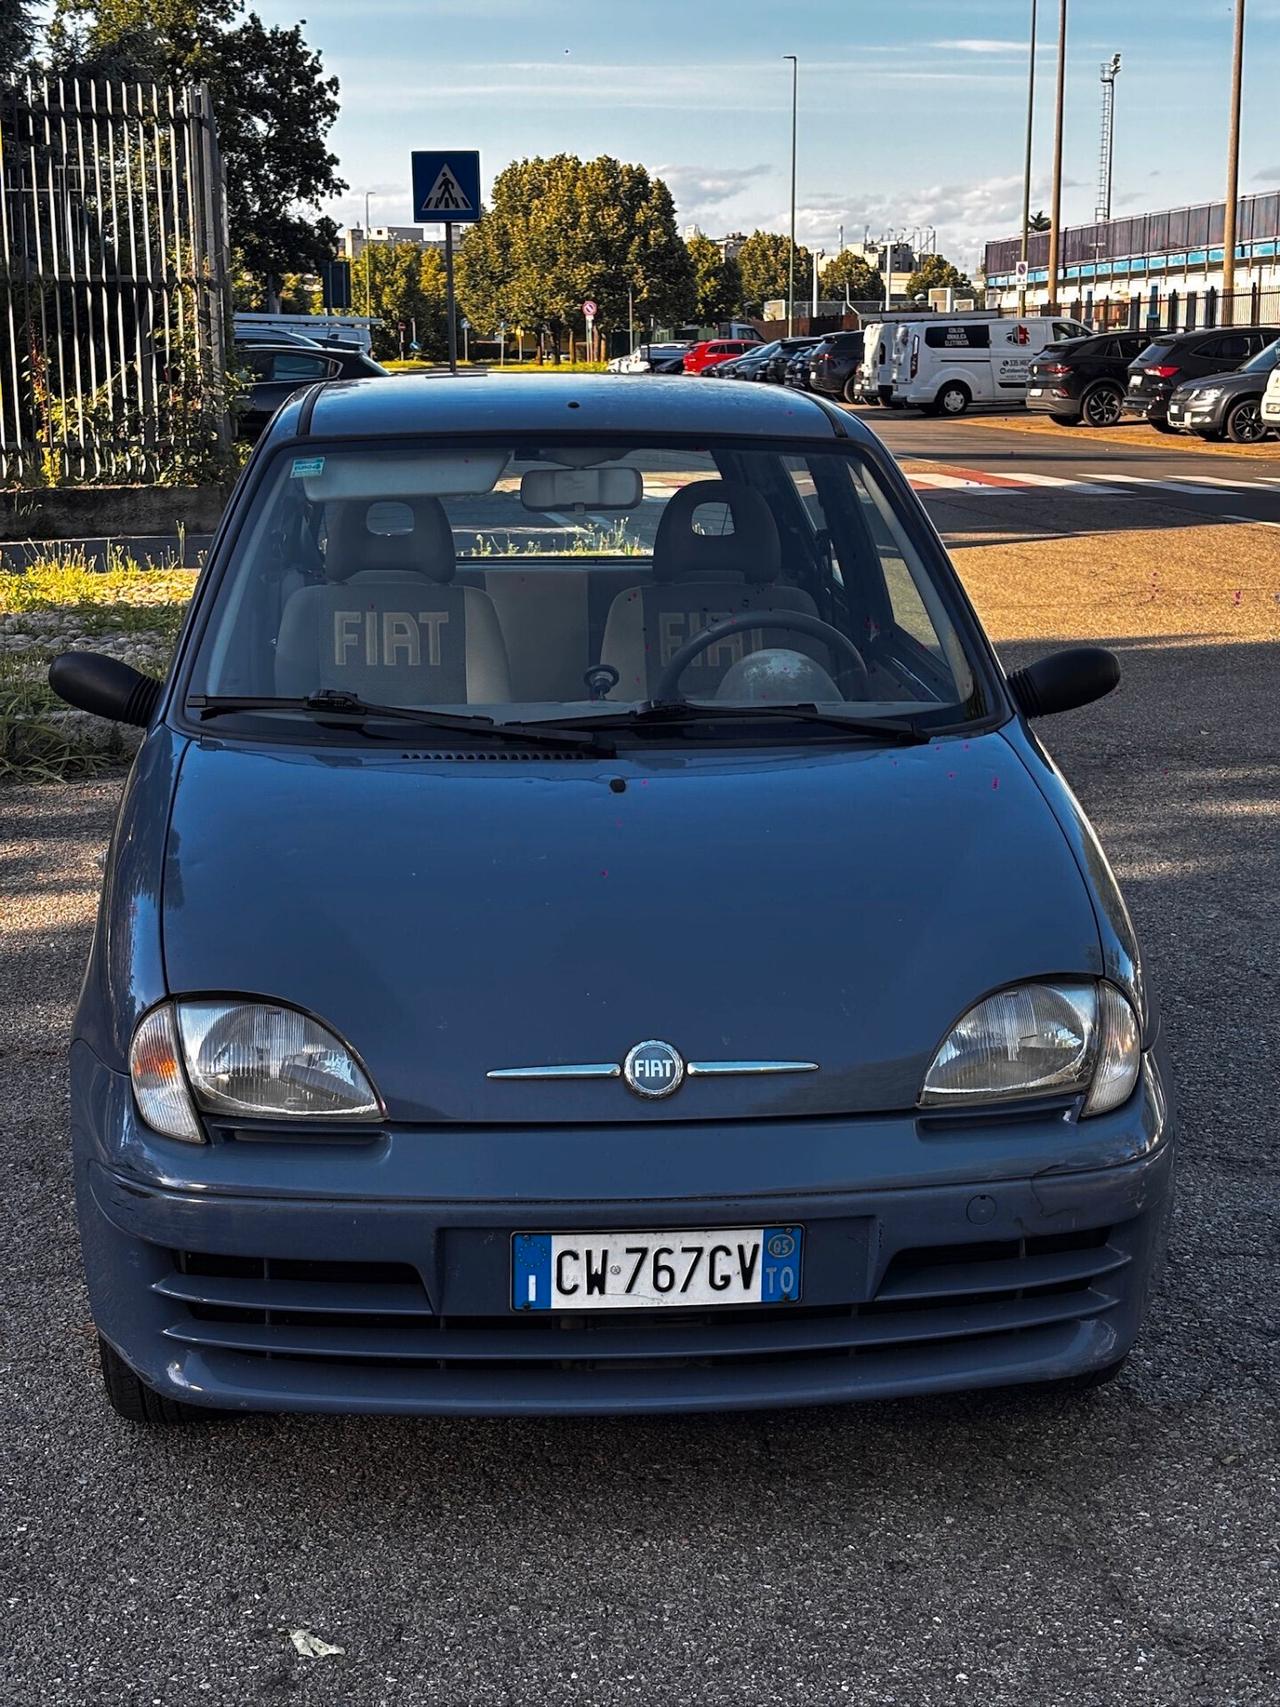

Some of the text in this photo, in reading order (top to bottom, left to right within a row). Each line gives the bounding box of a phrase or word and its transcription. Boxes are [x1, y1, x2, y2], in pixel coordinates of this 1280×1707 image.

[334, 611, 449, 666] FIAT
[634, 1059, 673, 1078] FIAT
[556, 1243, 760, 1296] CW 767GV
[765, 1266, 794, 1294] TO
